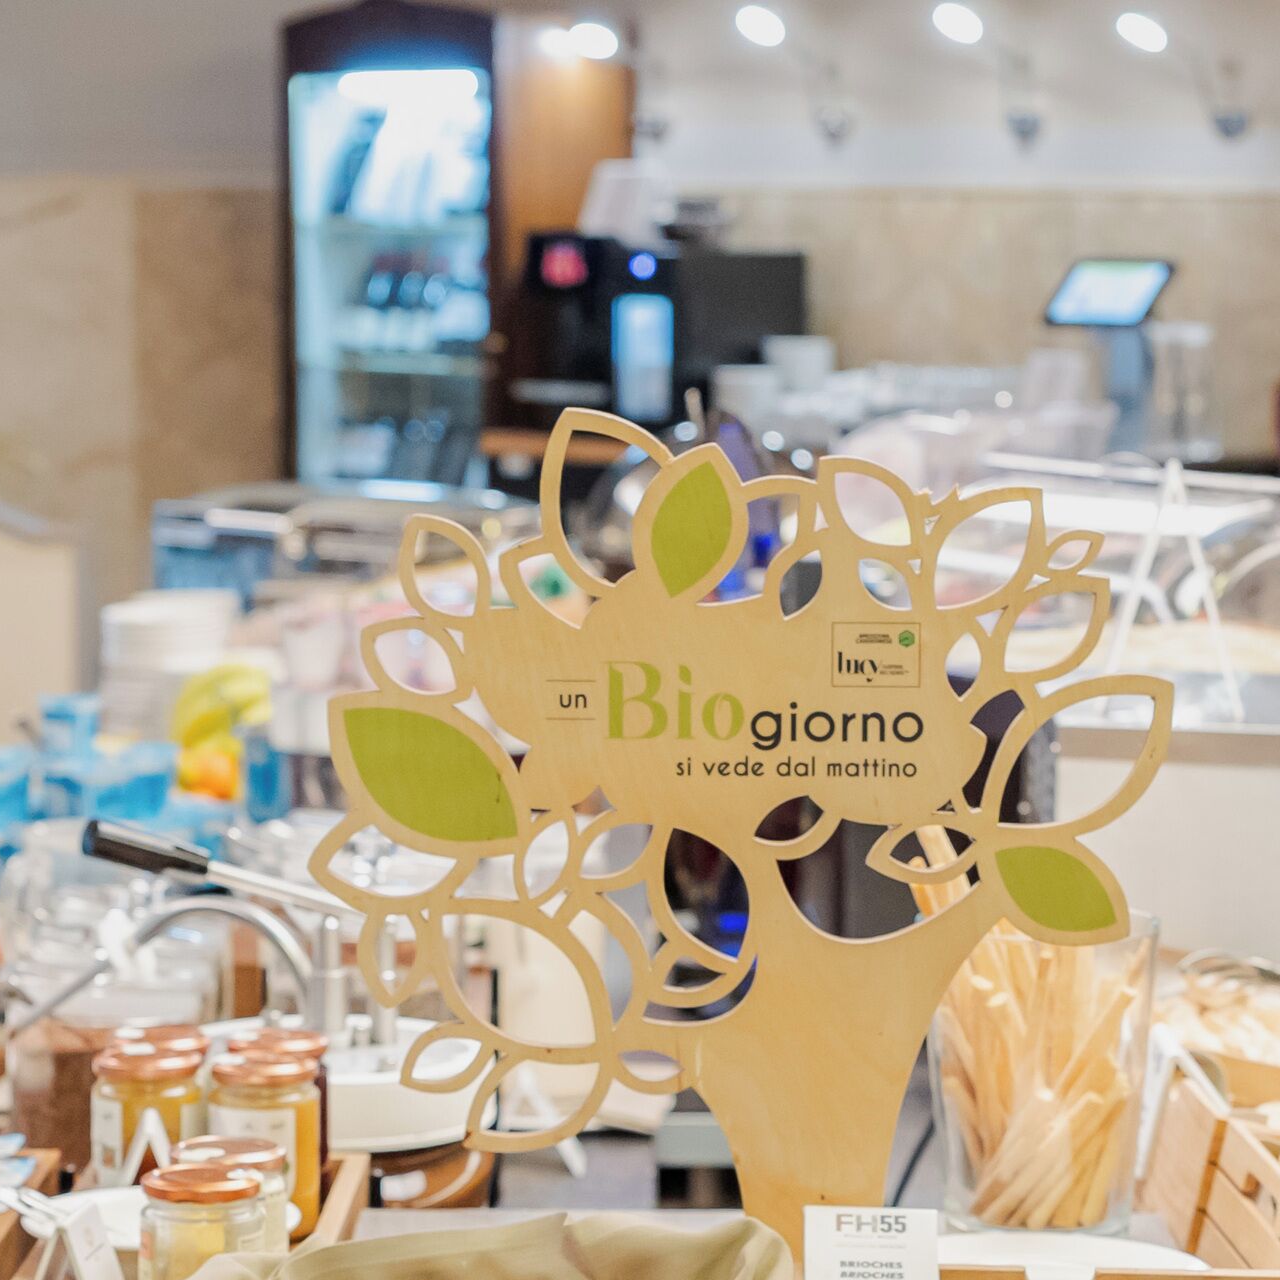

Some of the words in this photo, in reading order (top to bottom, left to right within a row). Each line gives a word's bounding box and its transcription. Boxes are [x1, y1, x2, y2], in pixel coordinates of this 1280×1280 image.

[559, 693, 588, 709] un
[676, 757, 693, 777] si
[703, 756, 765, 777] vede
[776, 756, 816, 777] dal
[827, 758, 918, 778] mattino
[835, 1213, 907, 1234] FH55
[839, 1260, 903, 1269] BRIOCHES
[840, 1271, 904, 1280] BRIOCHES
